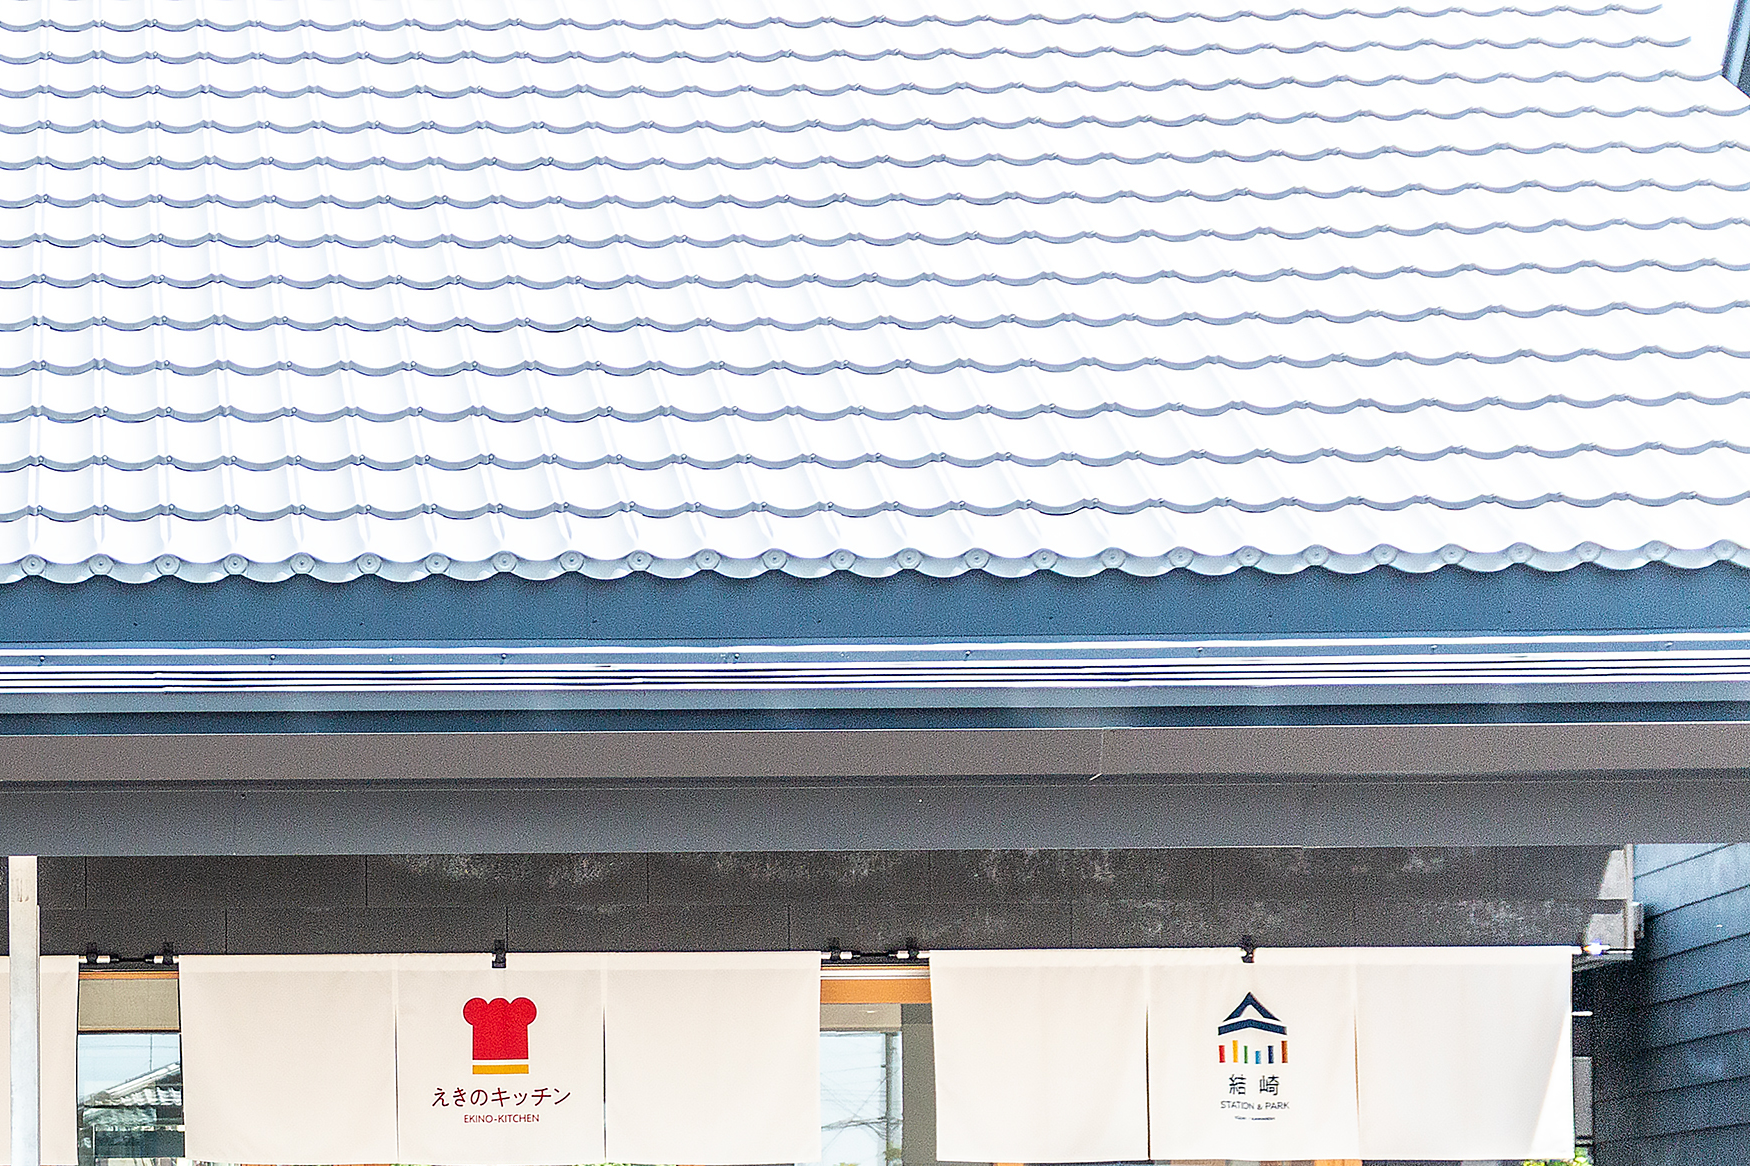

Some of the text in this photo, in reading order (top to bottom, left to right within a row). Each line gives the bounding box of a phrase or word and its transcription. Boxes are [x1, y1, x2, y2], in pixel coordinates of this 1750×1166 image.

[1229, 1074, 1280, 1096] 結崎
[432, 1087, 571, 1107] えきのキッチン
[1220, 1100, 1254, 1109] STATION
[1265, 1101, 1290, 1109] PARK
[463, 1114, 540, 1123] EKINO-KITCHEN
